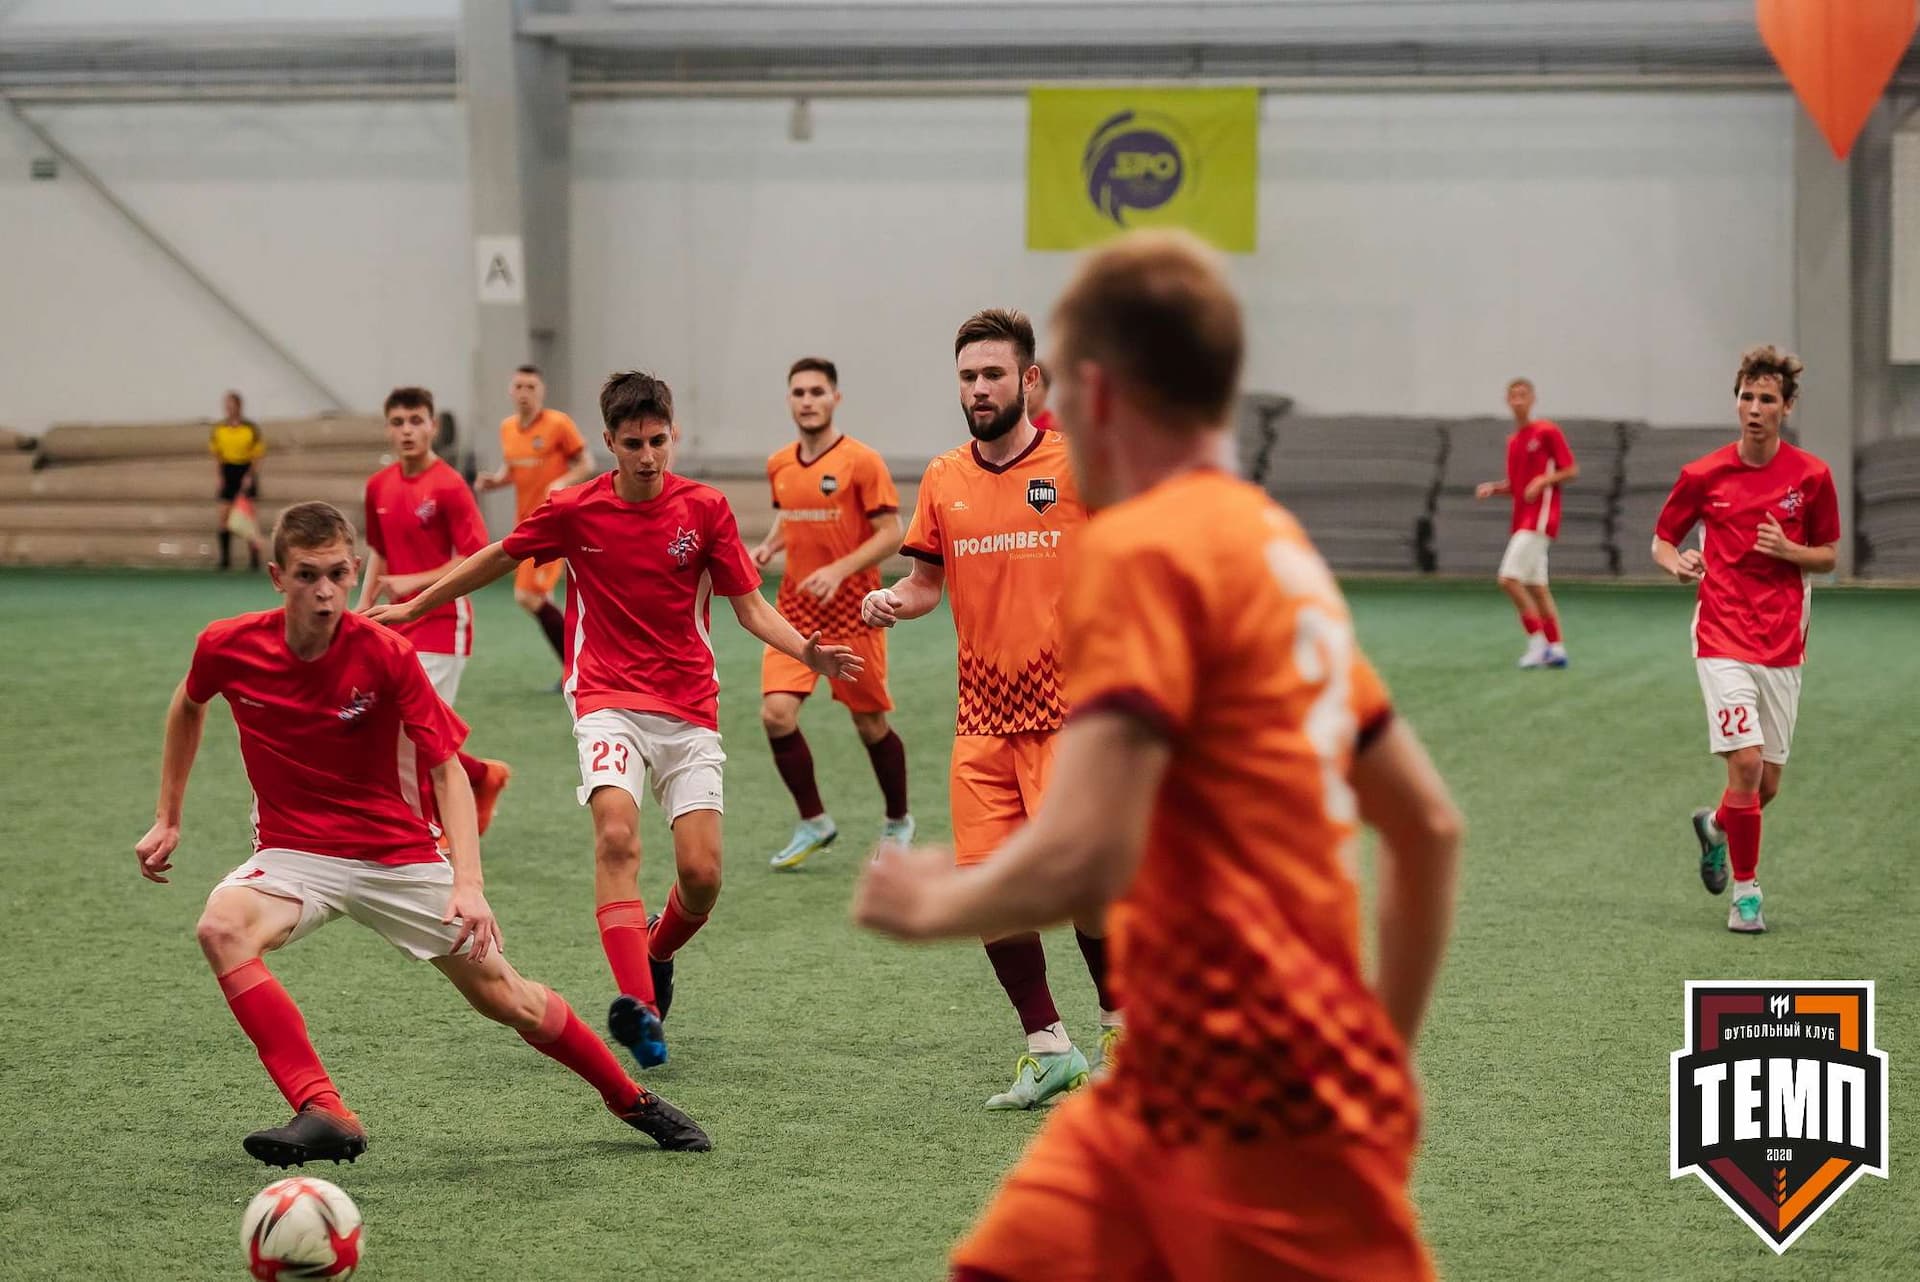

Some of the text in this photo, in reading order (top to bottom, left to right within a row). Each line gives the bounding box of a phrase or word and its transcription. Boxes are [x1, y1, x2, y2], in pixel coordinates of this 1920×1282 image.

[1029, 487, 1054, 502] ТЕМП
[1718, 706, 1752, 737] 22
[592, 740, 629, 775] 23
